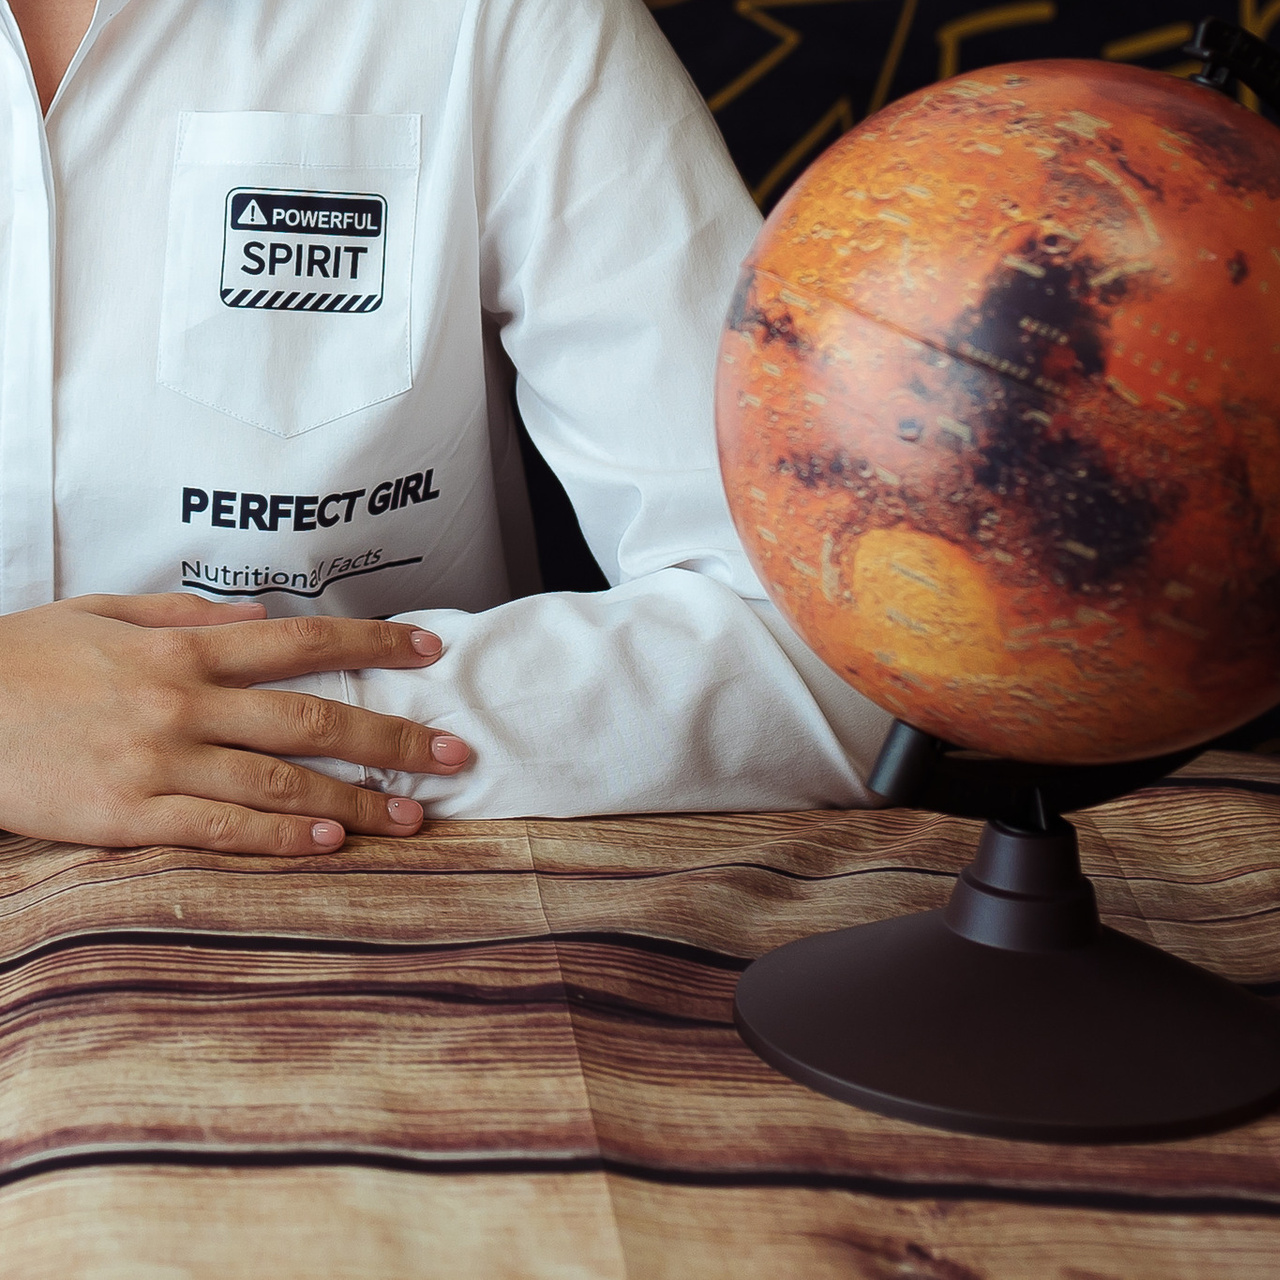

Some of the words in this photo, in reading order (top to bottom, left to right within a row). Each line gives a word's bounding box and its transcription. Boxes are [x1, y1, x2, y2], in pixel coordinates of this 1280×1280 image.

[271, 207, 379, 231] POWERFUL
[240, 240, 369, 280] SPIRIT
[181, 486, 366, 532] PERFECT
[367, 467, 440, 516] GIRL
[181, 559, 323, 589] Nutritional
[326, 548, 383, 576] Facts
